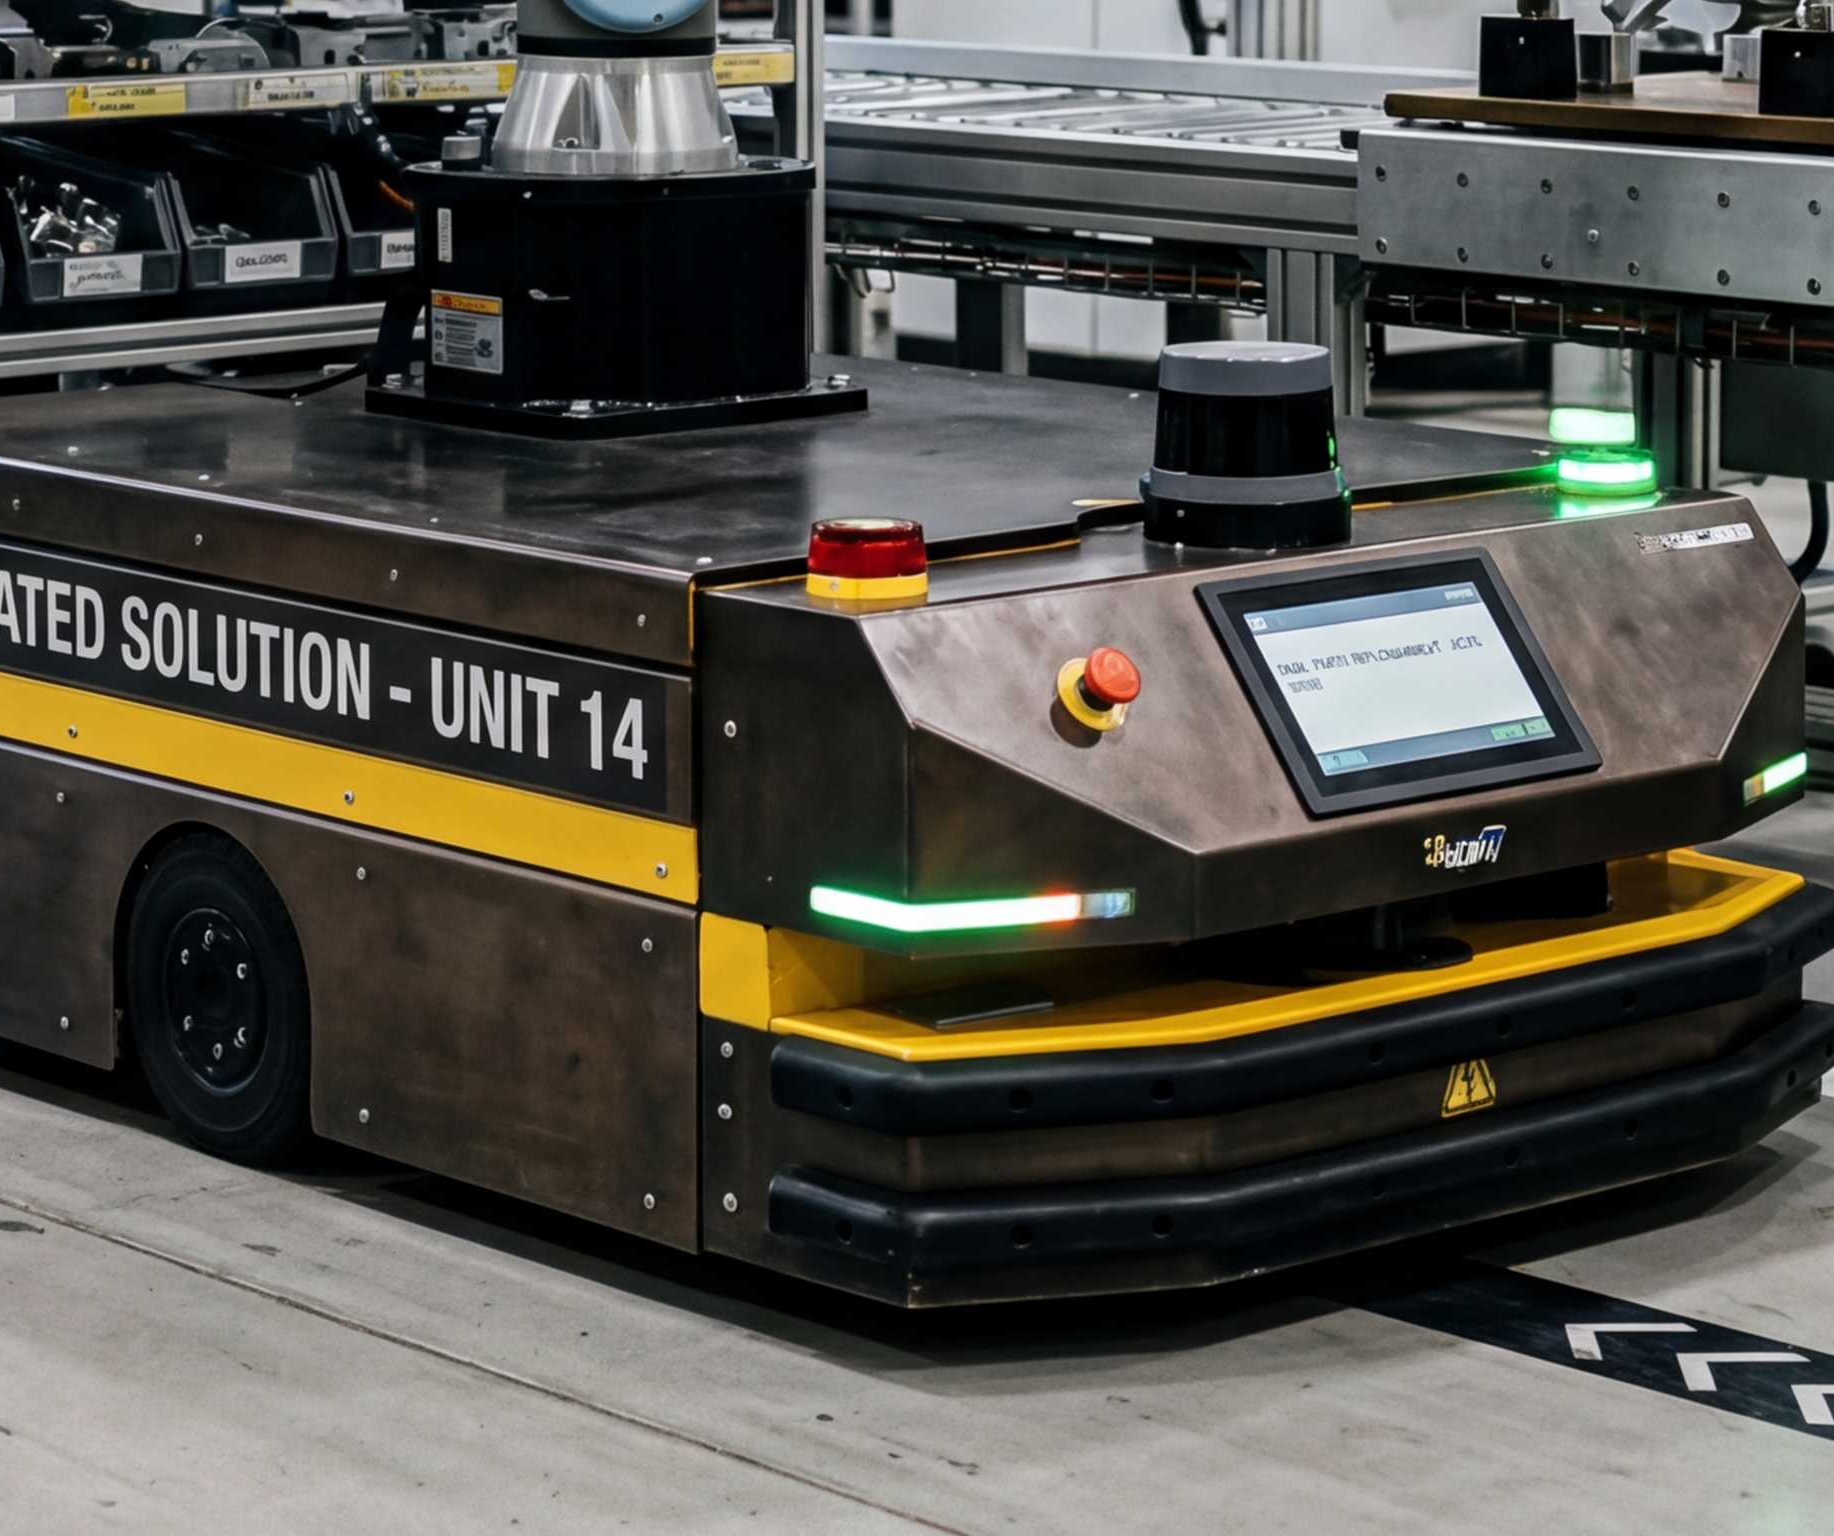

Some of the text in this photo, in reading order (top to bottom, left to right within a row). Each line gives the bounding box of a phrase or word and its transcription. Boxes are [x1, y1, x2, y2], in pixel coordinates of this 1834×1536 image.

[121, 595, 371, 721] SOLUTION
[389, 685, 412, 704] -
[431, 656, 560, 759] UNIT
[580, 690, 648, 780] 14
